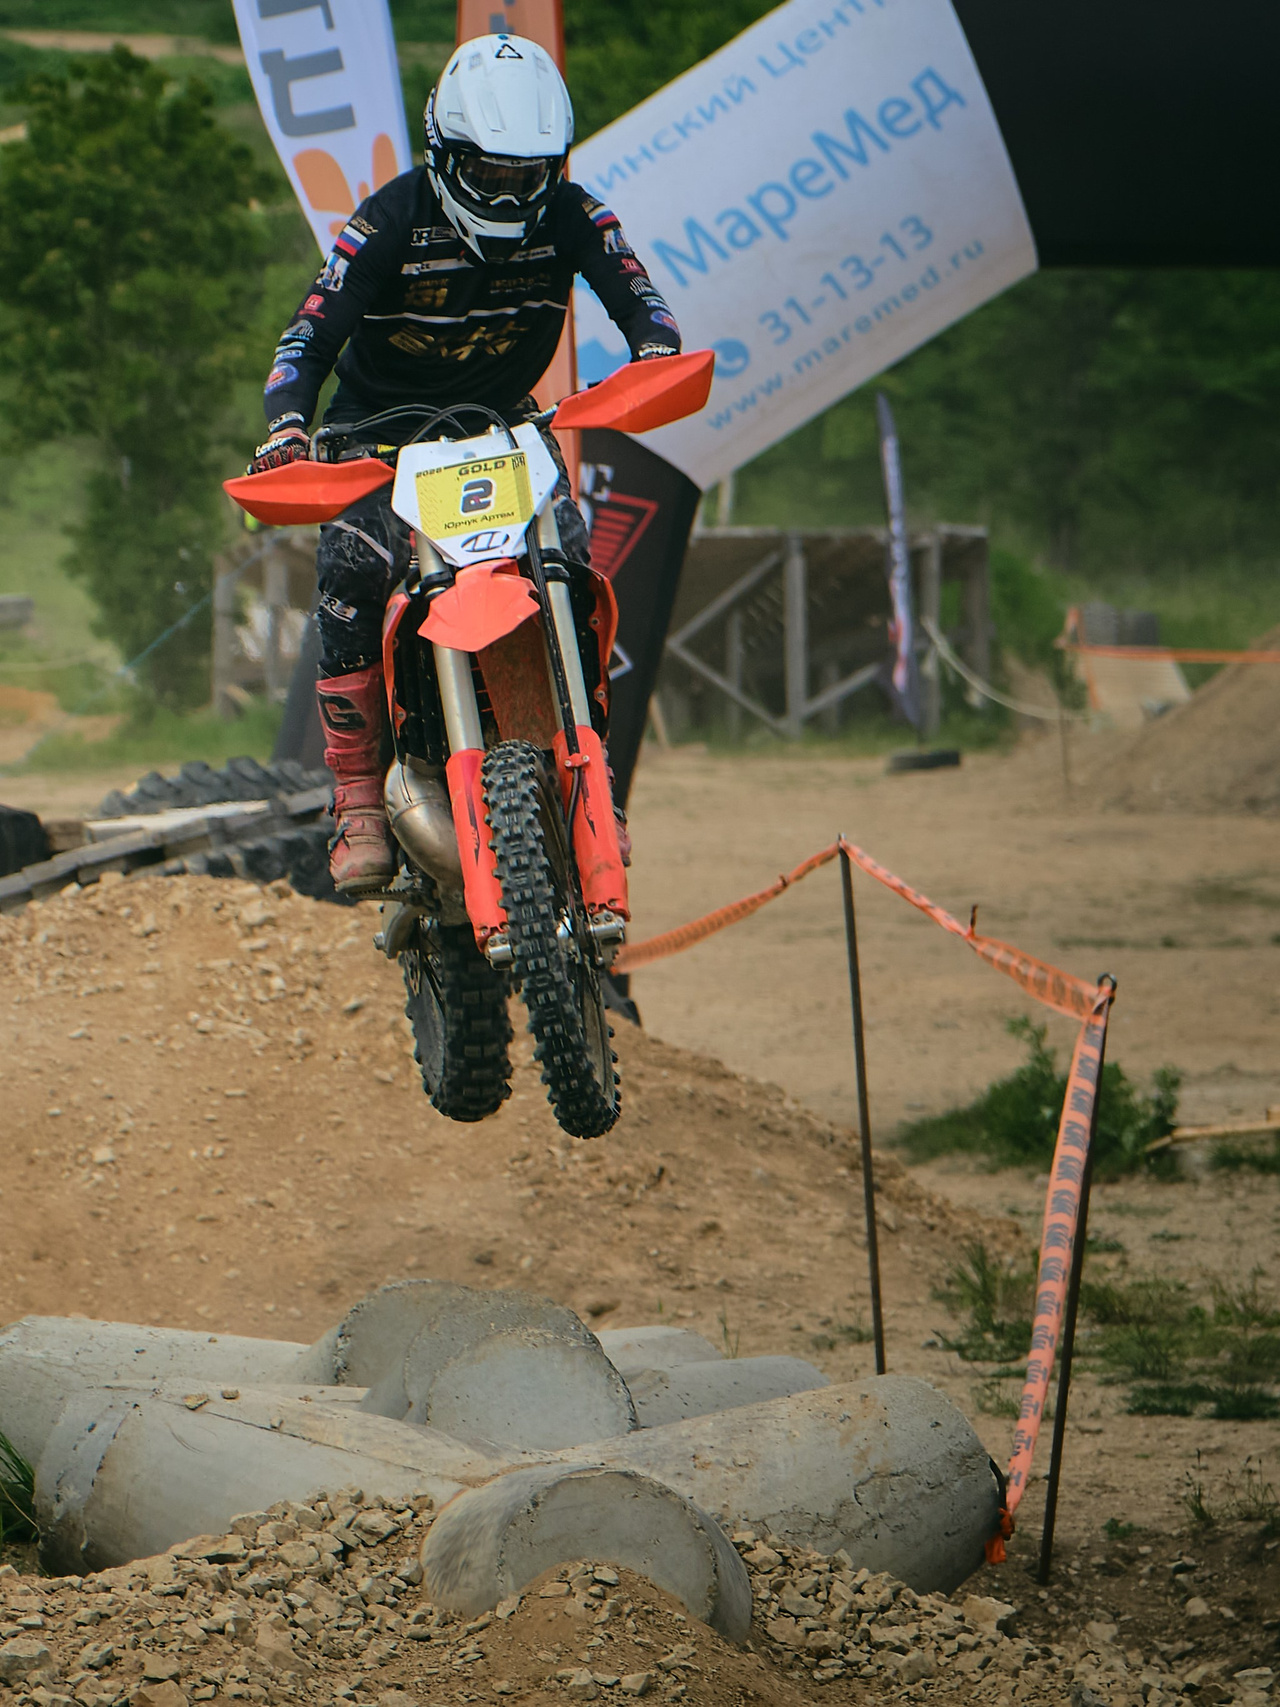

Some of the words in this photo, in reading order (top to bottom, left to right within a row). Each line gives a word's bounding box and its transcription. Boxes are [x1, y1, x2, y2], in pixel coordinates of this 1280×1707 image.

[650, 65, 968, 289] МареМед
[758, 214, 934, 346] 31-13-13
[707, 239, 985, 430] www.maremed.ru
[457, 459, 506, 477] GOLD
[460, 479, 494, 514] 2
[444, 517, 478, 530] Юрчук
